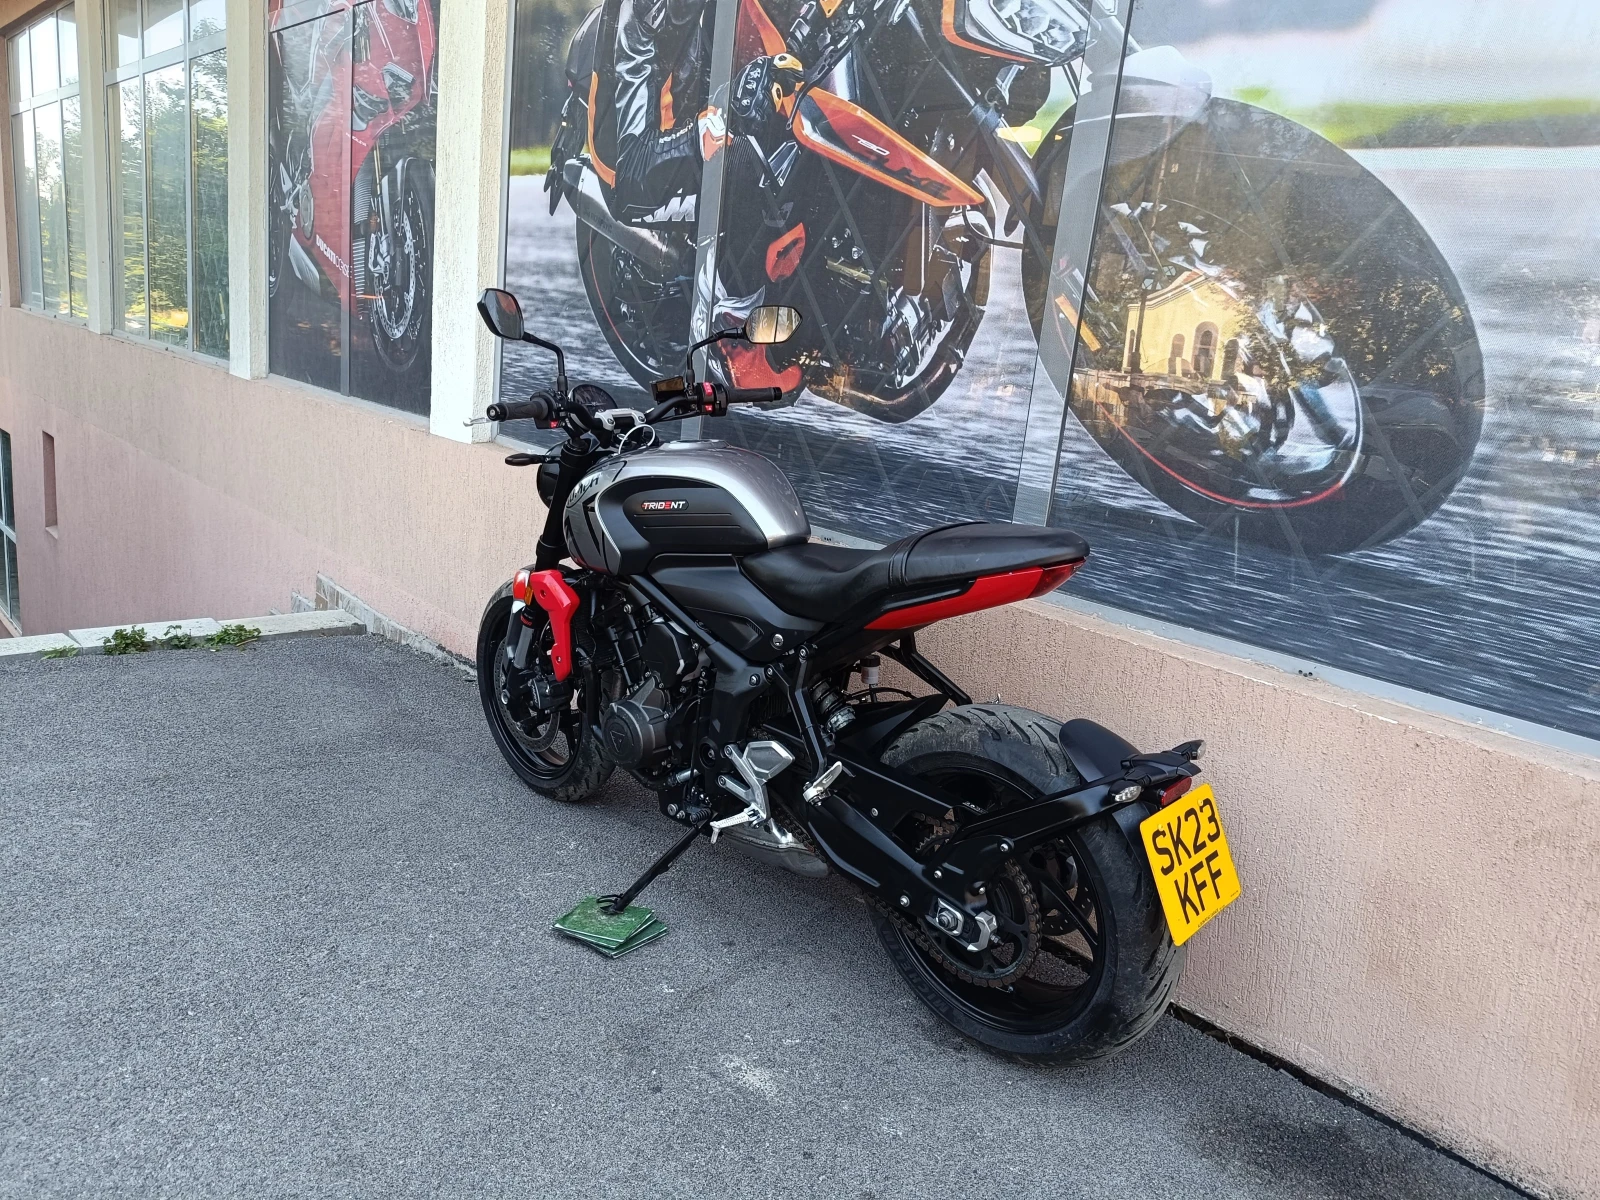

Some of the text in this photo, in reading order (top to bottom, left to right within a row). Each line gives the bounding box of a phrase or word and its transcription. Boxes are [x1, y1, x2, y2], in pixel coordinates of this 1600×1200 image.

[642, 500, 686, 510] TRIDENT
[1151, 797, 1221, 876] SK23
[1173, 849, 1222, 925] KFF
